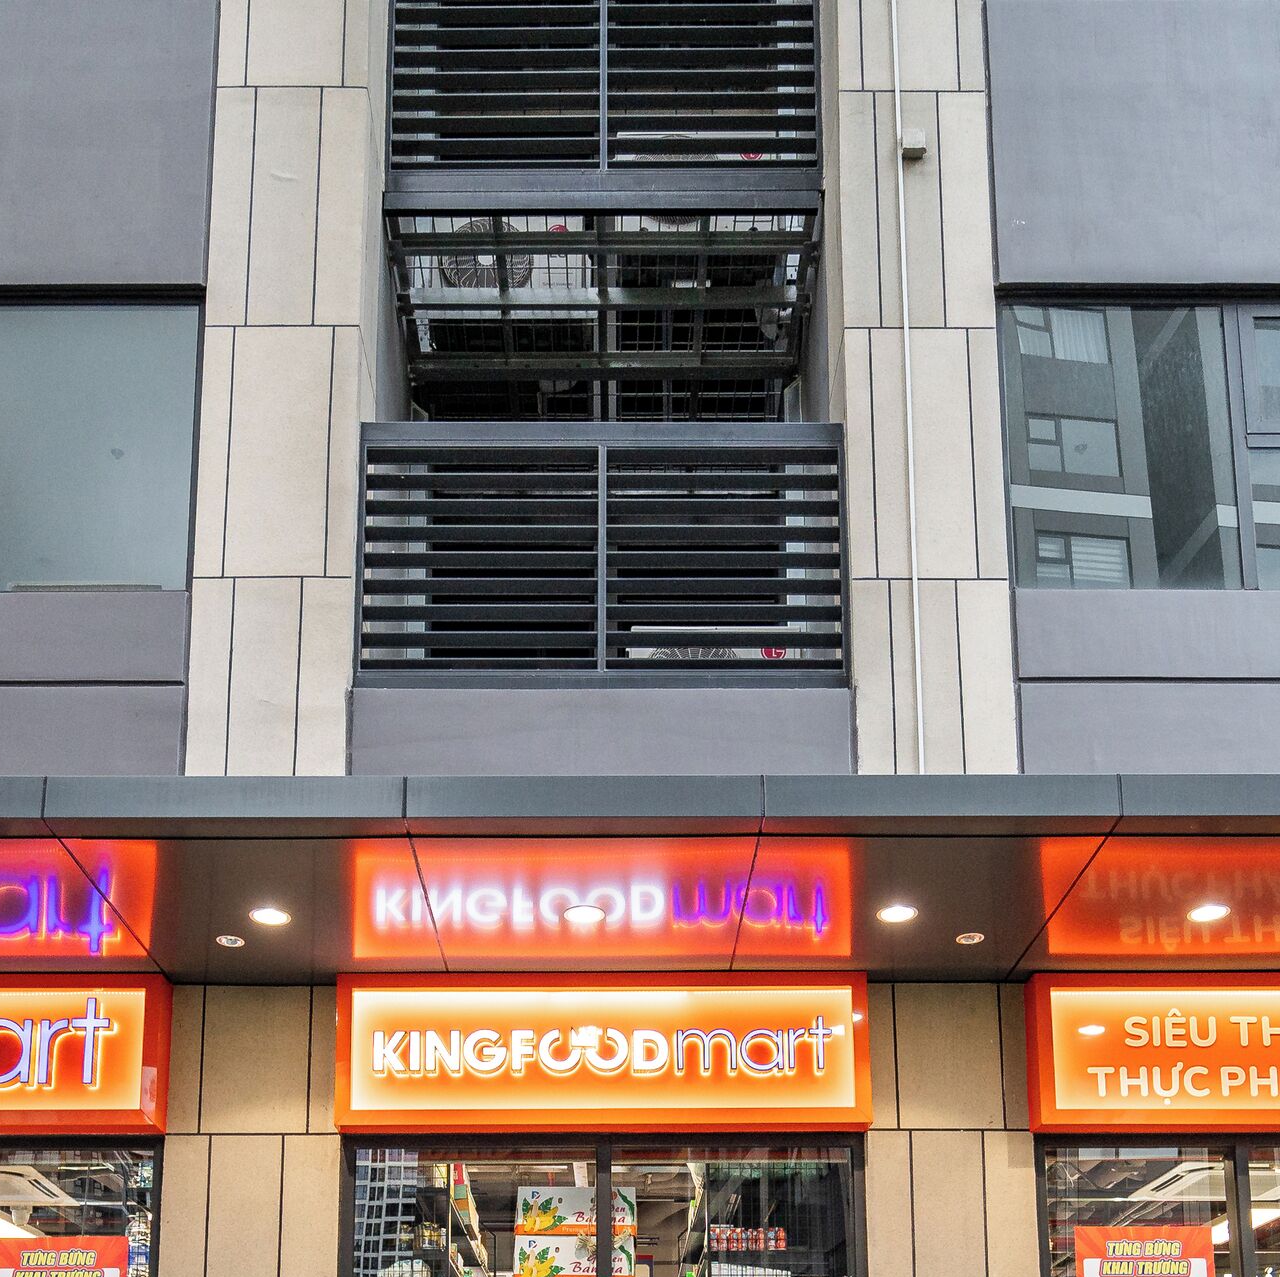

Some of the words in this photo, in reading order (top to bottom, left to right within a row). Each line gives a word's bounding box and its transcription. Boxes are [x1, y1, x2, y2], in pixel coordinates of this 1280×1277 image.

[1124, 1008, 1217, 1048] SIÊU
[1086, 1061, 1209, 1105] THỰC
[1107, 1241, 1142, 1257] TƯNG
[1144, 1240, 1181, 1256] BỪNG
[21, 1251, 55, 1266] TƯNG
[58, 1250, 96, 1266] BỪNG
[1102, 1260, 1134, 1275] KHAI
[1137, 1259, 1190, 1275] TRƯƠNG
